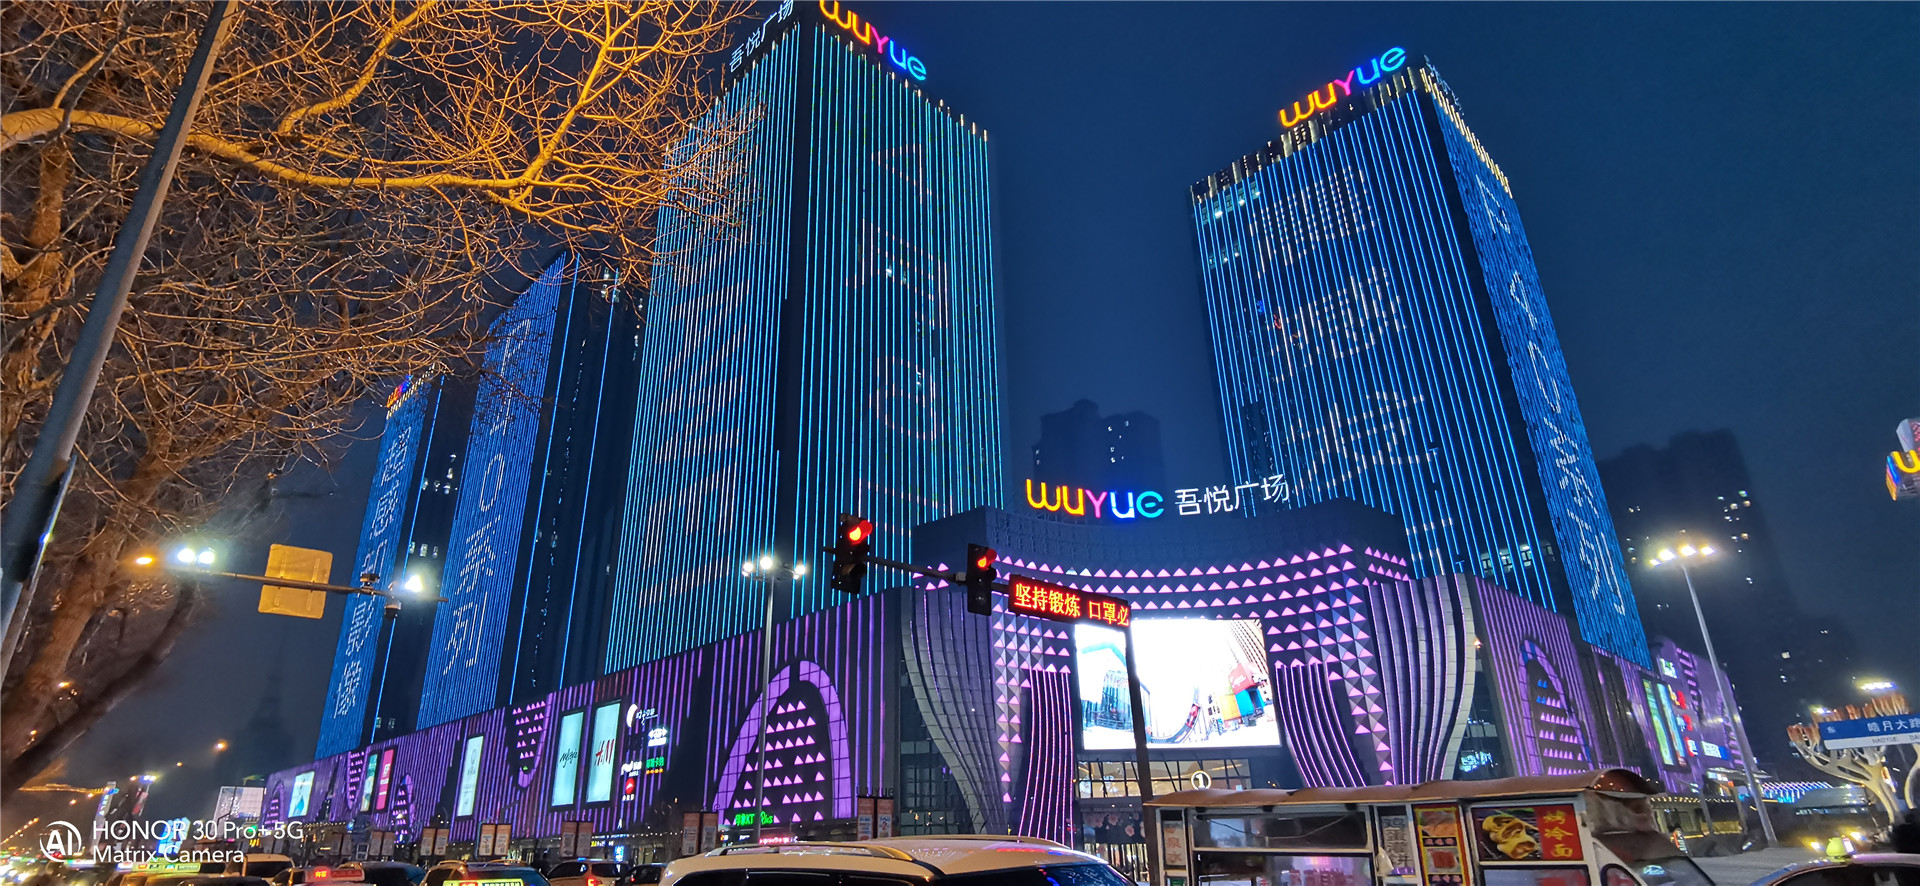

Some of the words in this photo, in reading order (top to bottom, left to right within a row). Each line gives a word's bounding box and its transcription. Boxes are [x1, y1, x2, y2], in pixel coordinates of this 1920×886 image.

[728, 0, 794, 73] 吾悦广场
[1174, 474, 1290, 516] 吾悦广场
[1014, 583, 1080, 617] 坚持锻炼
